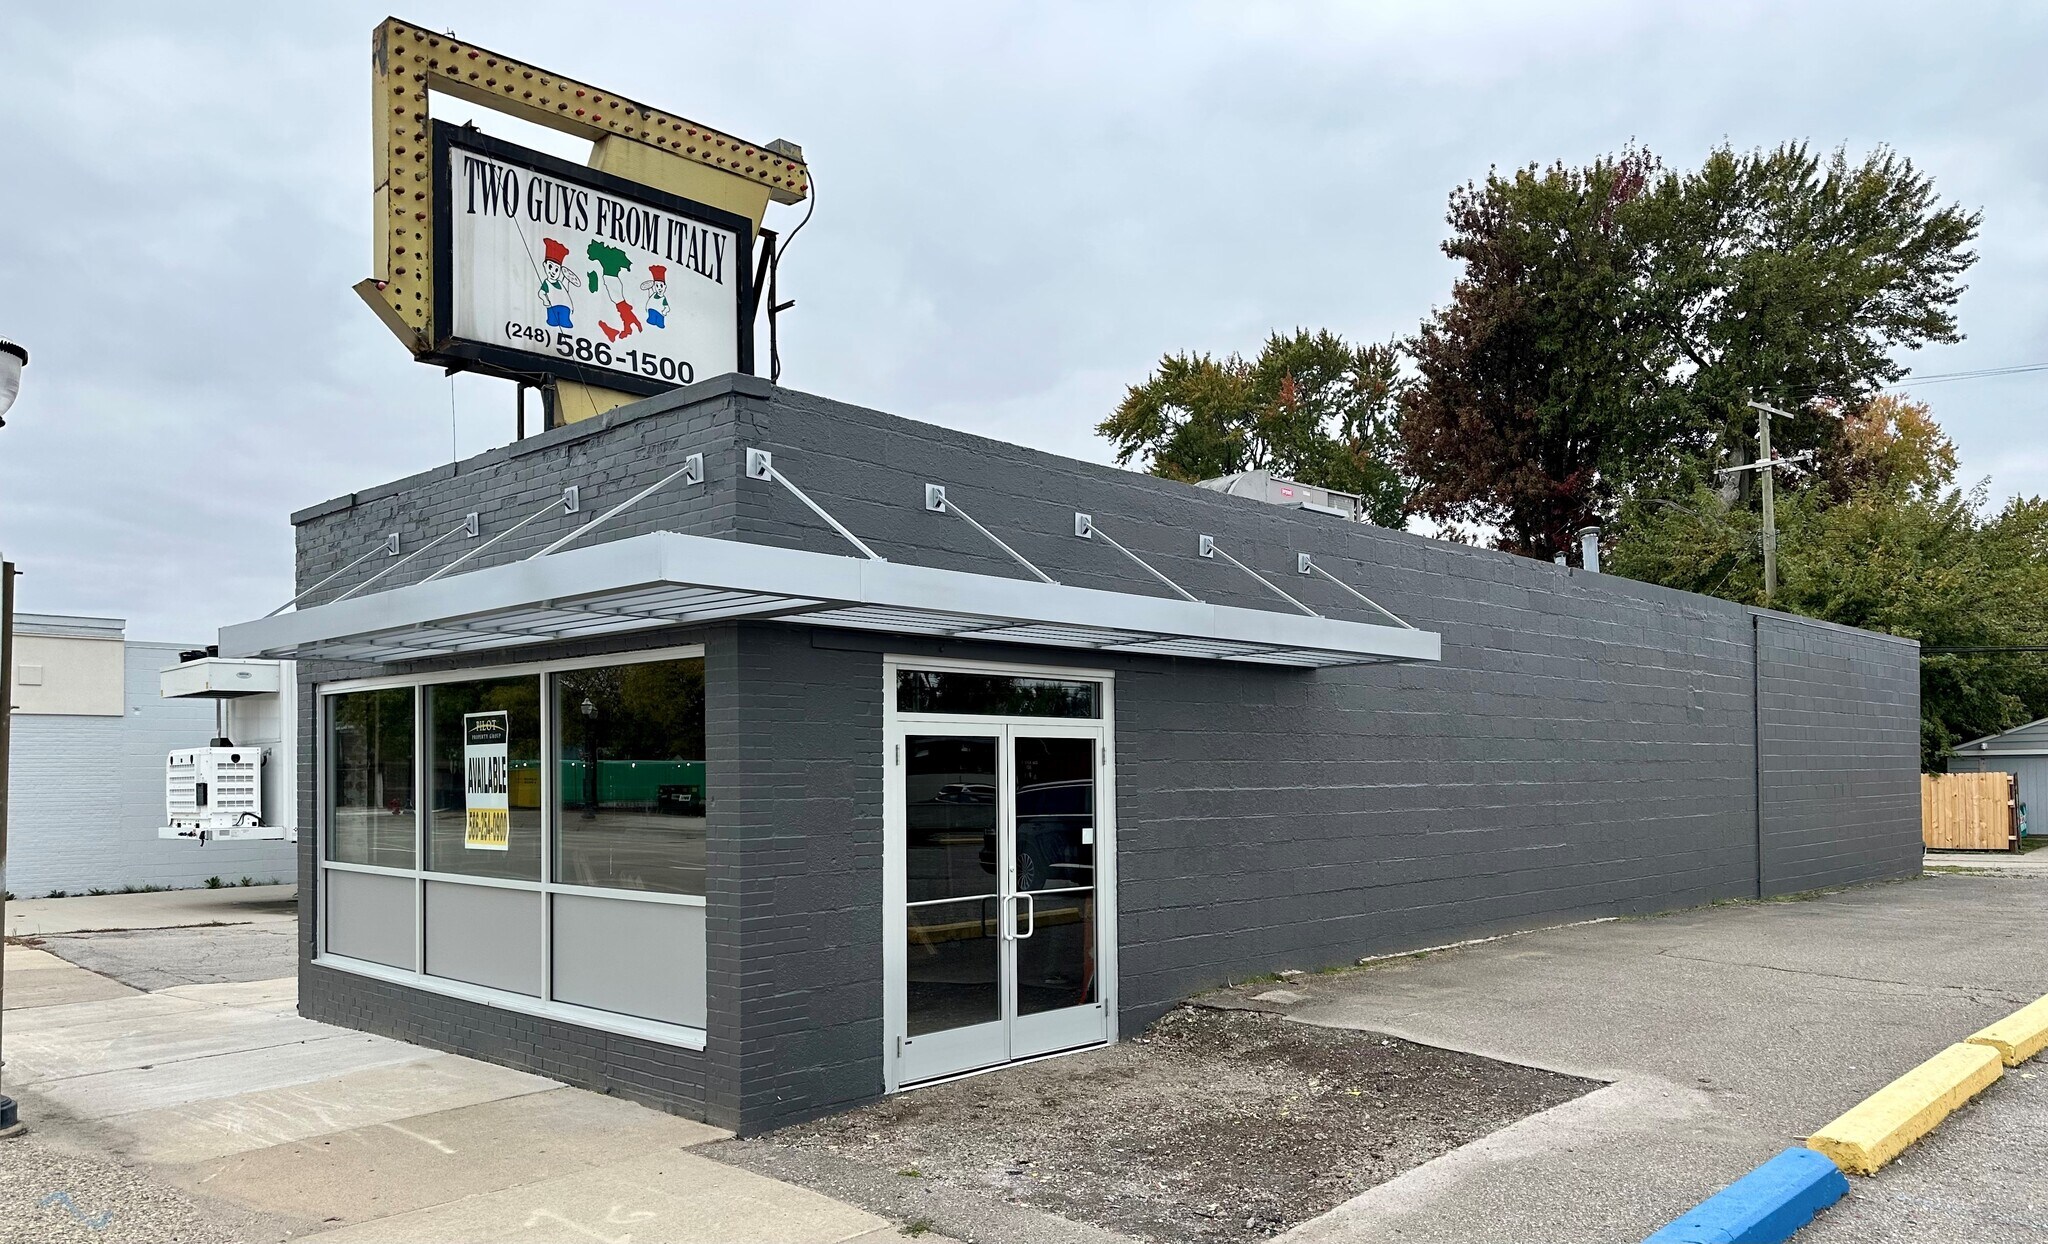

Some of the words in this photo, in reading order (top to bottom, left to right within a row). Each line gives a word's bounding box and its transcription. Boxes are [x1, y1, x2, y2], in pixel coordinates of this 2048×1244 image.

[464, 156, 519, 218] TWO
[527, 176, 588, 231] GUYS
[596, 196, 661, 254] FROM
[666, 218, 726, 285] ITALY
[505, 321, 551, 348] (248)
[556, 332, 694, 384] 586-1500
[475, 719, 497, 731] PILOT
[468, 756, 506, 794] AVAILABLE
